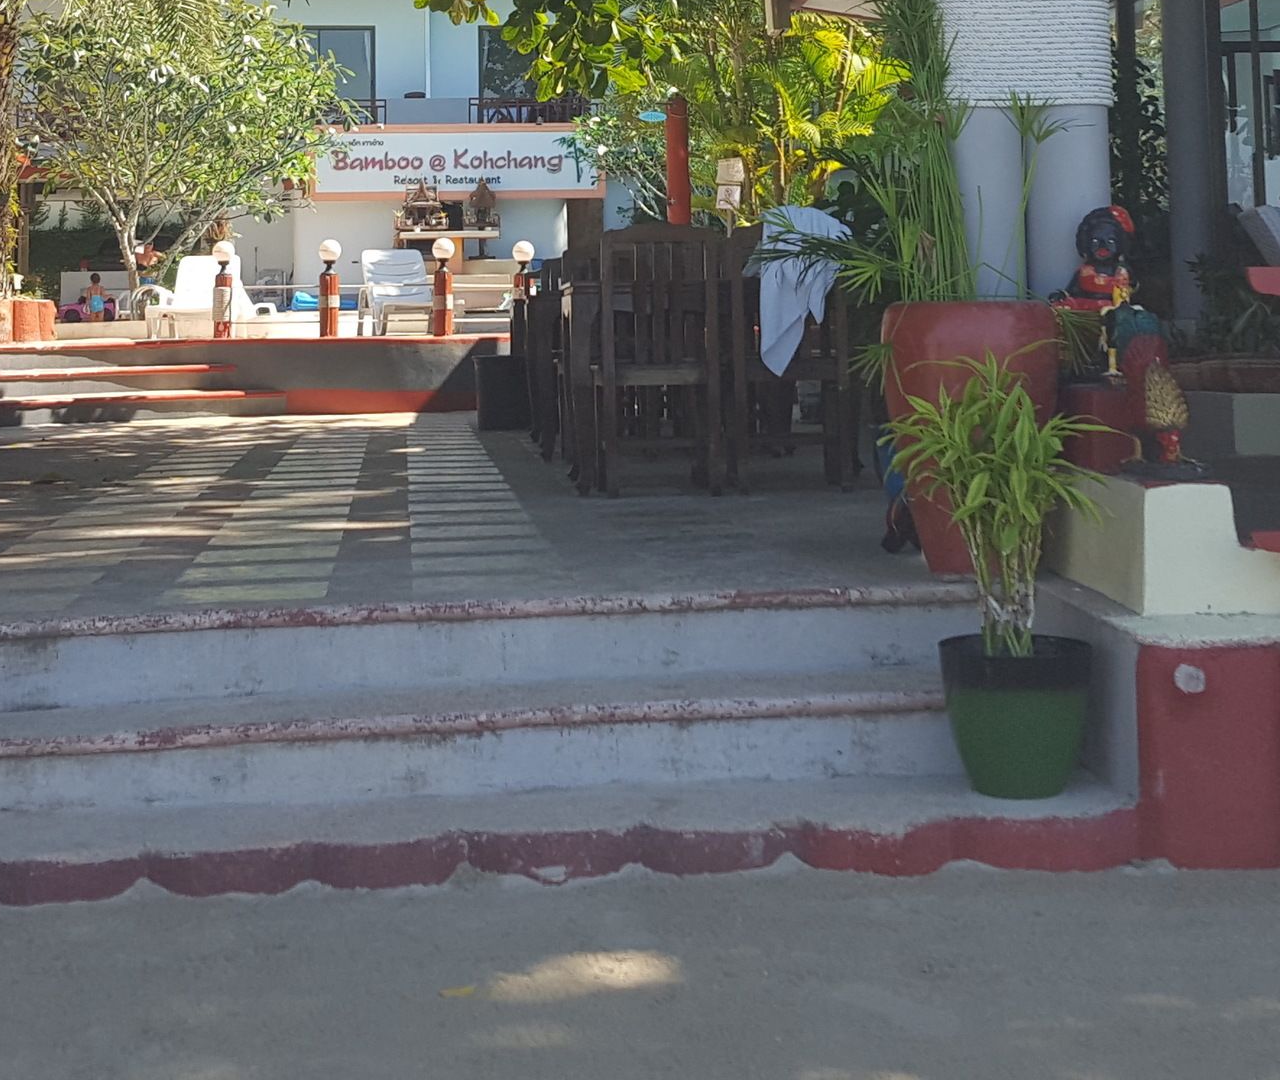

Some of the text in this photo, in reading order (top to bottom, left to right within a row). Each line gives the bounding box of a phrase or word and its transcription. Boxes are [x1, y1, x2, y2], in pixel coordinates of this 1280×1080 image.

[330, 147, 563, 174] Bamboo @ Kohchang
[445, 174, 501, 185] Restauant
